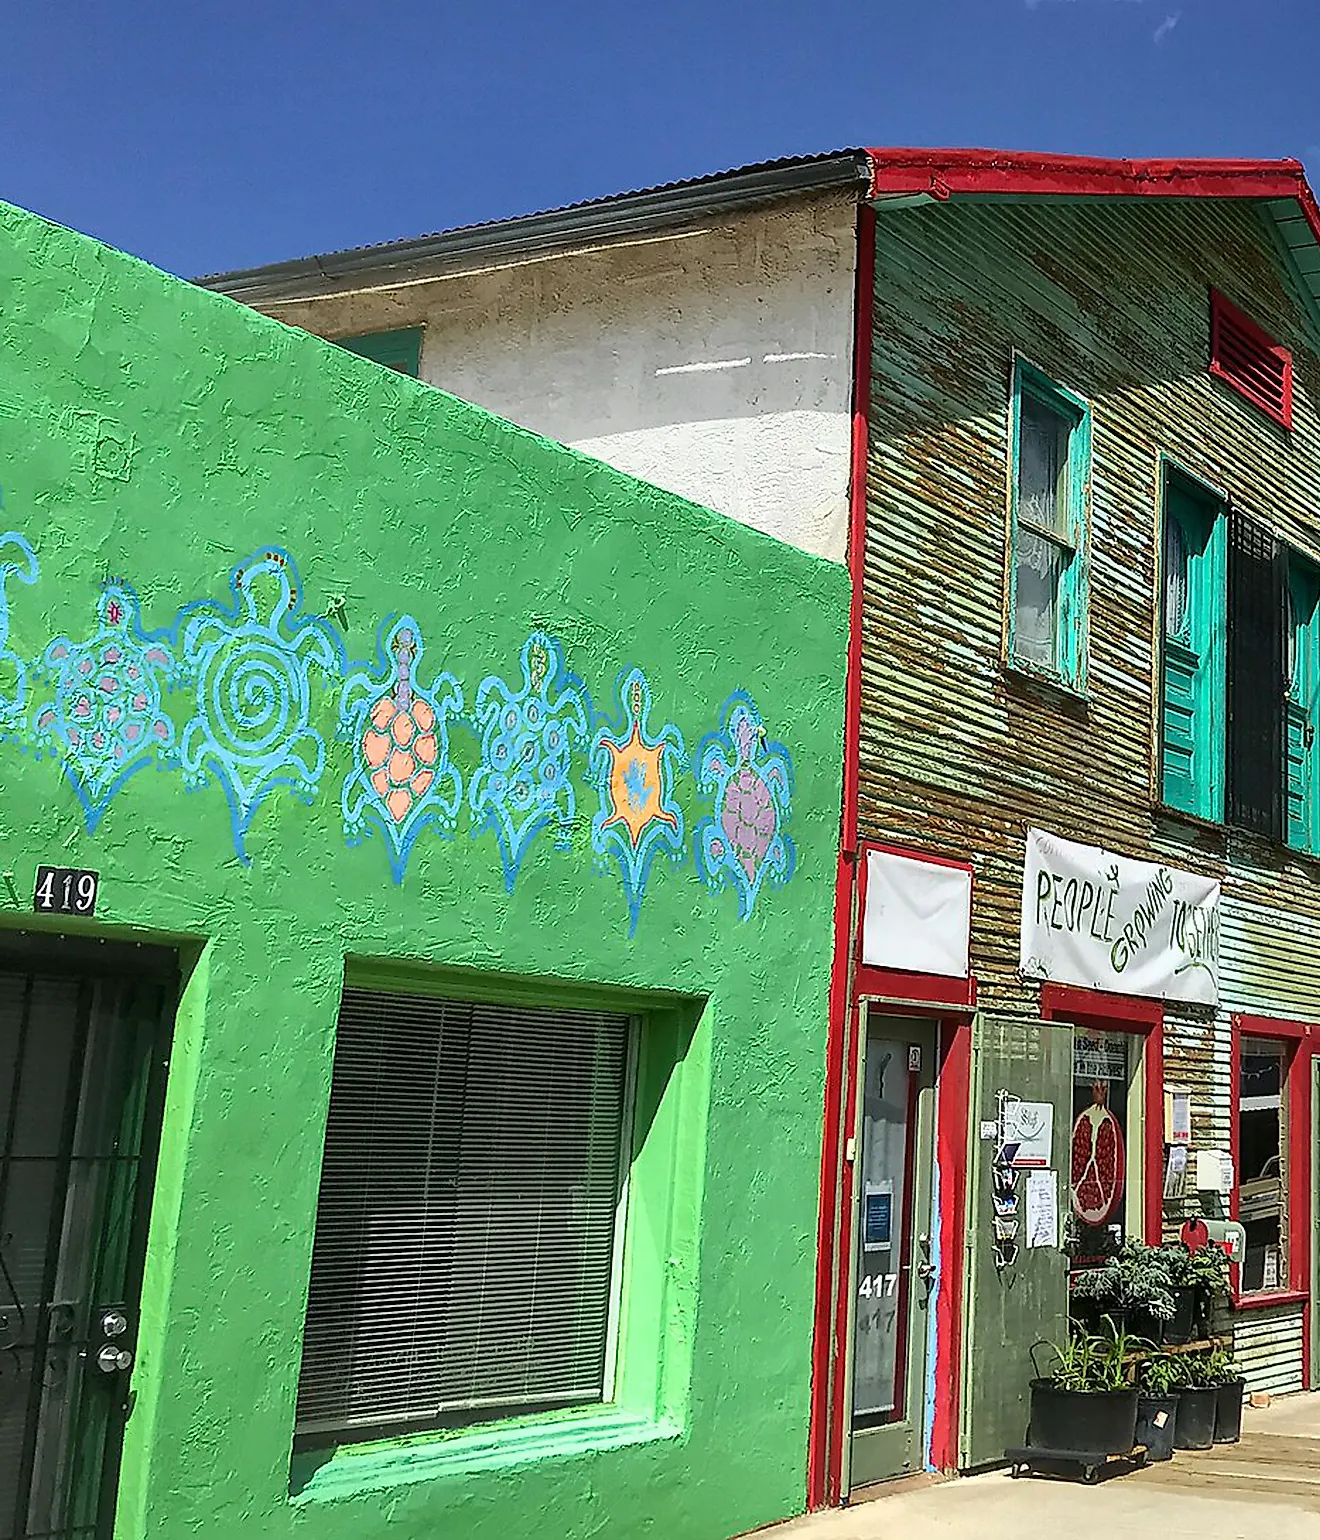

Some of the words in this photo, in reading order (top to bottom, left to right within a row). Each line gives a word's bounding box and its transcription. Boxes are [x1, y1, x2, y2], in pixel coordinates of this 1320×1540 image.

[36, 872, 95, 911] 419
[1036, 869, 1119, 942] PEOPLE
[1111, 867, 1174, 973] GROWING
[858, 1273, 897, 1299] 417
